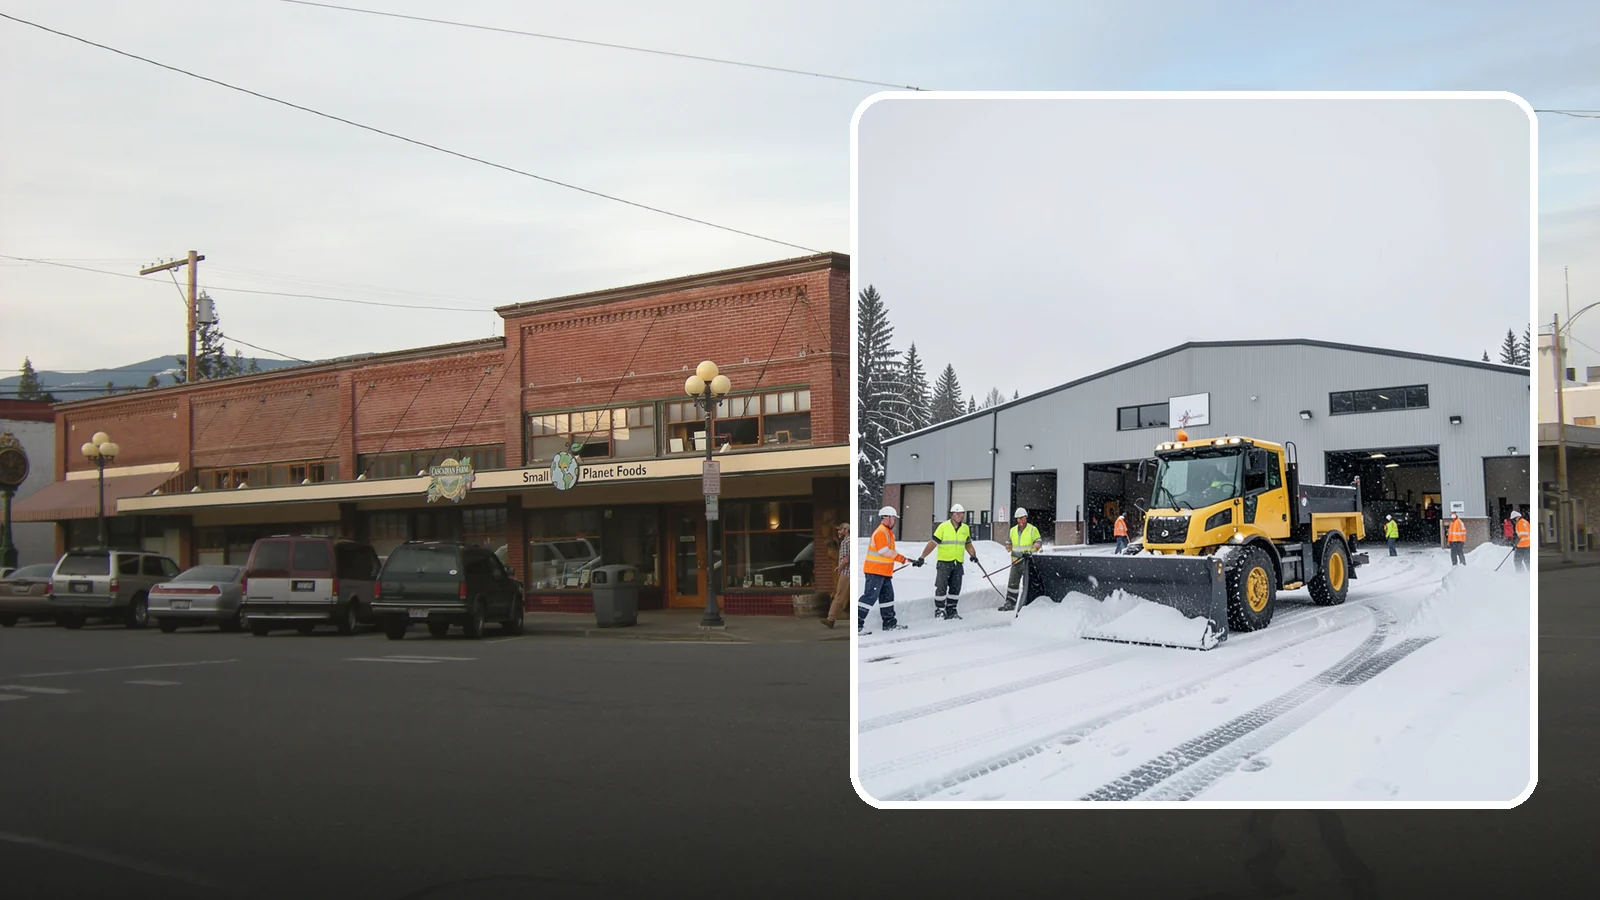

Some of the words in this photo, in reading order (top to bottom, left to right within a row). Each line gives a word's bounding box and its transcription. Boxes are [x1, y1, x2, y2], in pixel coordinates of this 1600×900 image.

[523, 471, 549, 483] Small
[583, 468, 614, 479] Planet
[617, 464, 647, 476] Foods
